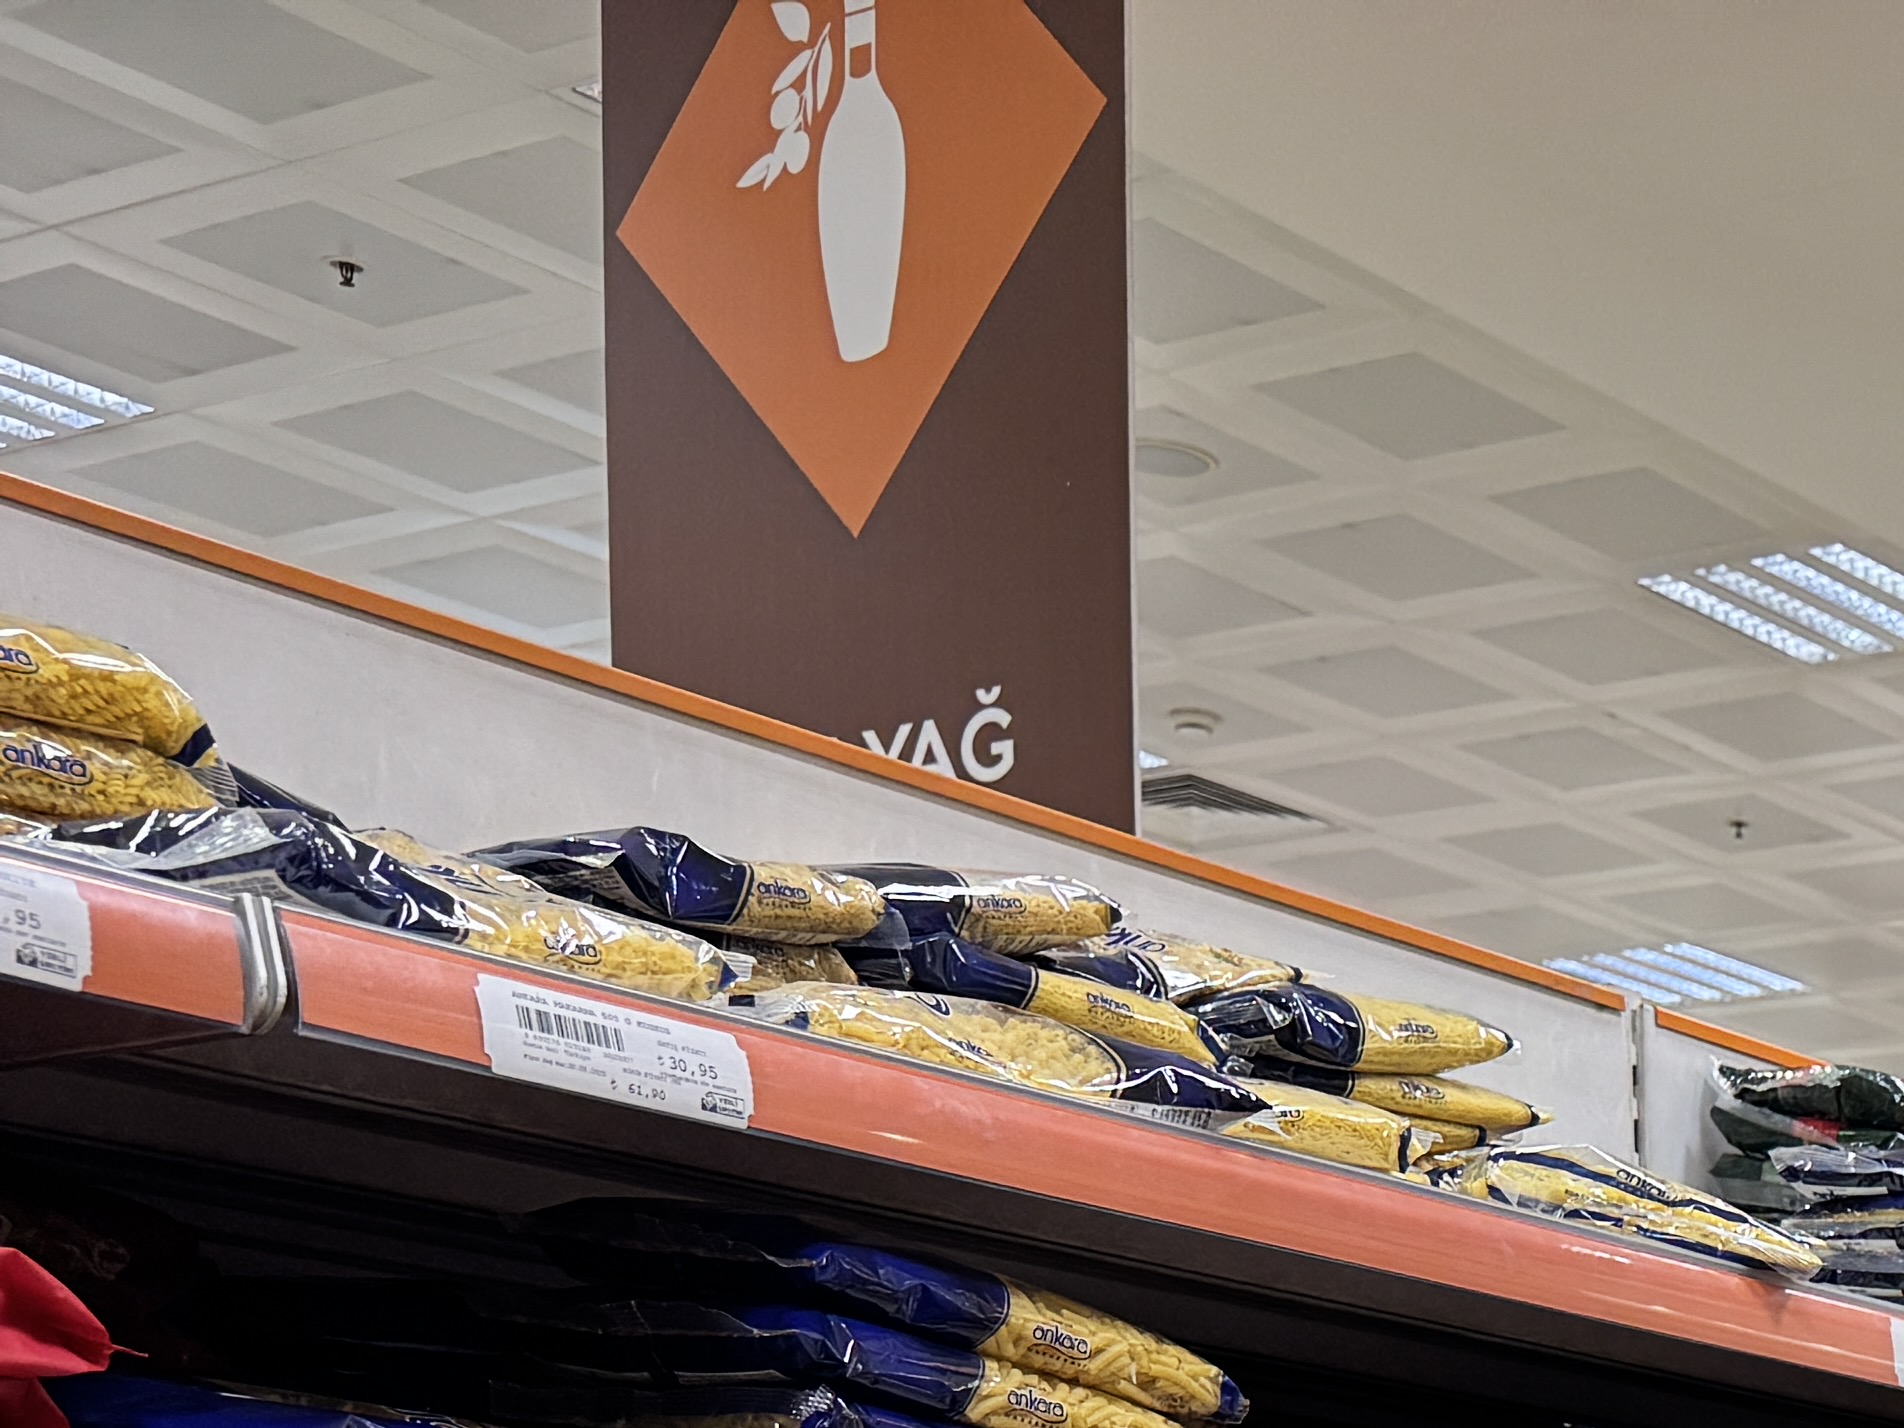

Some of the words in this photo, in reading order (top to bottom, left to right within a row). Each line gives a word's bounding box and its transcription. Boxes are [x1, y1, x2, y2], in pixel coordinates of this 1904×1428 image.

[757, 878, 809, 903] ankara
[977, 893, 1027, 913] ankara
[1032, 1324, 1089, 1356] ankara
[1007, 1388, 1066, 1419] ankara
